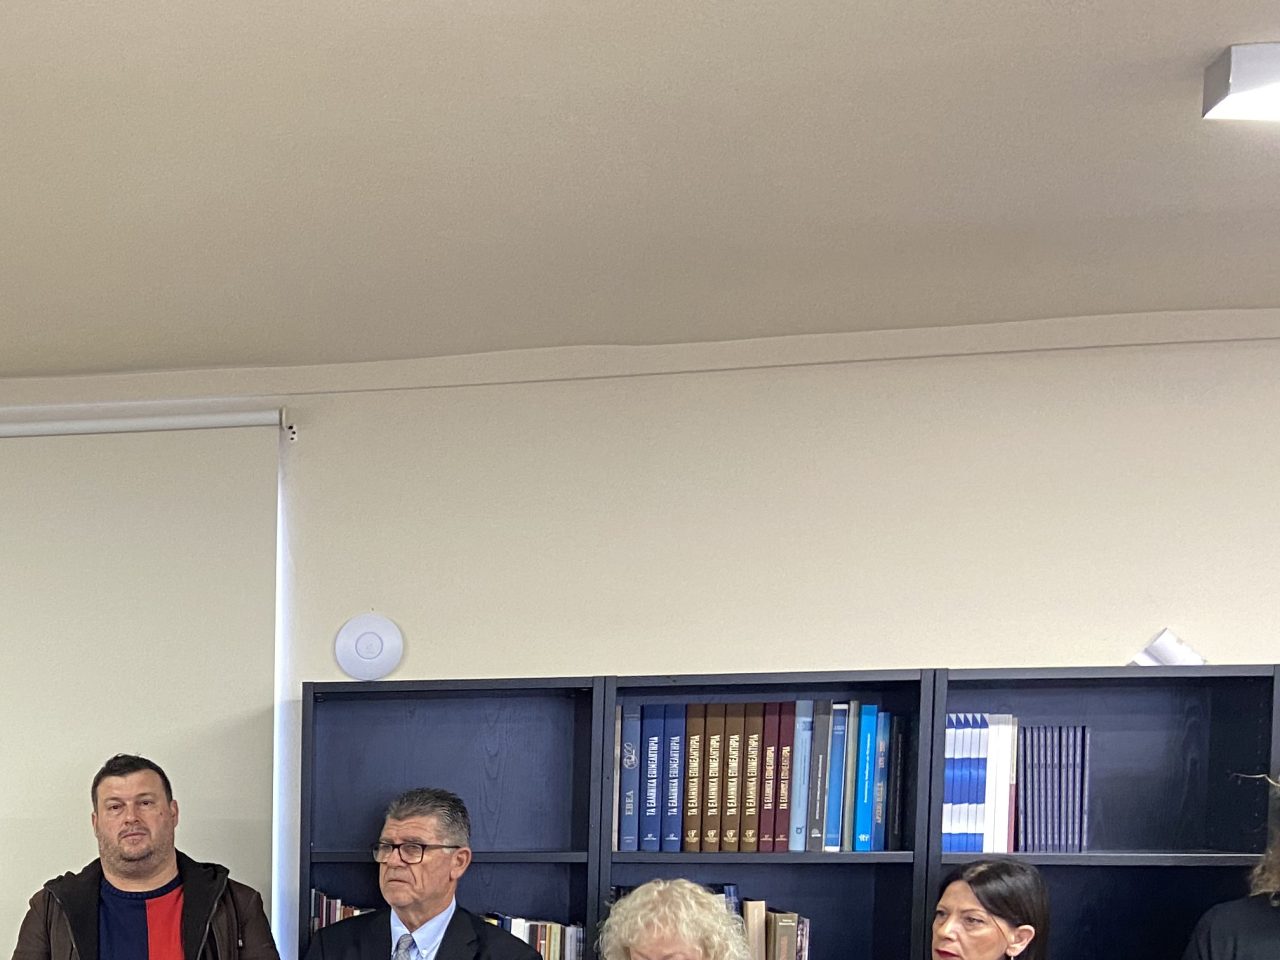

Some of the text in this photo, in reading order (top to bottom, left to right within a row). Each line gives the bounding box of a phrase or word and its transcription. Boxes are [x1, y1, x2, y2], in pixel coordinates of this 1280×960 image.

[646, 807, 656, 816] ΤΑ
[668, 807, 678, 816] ΤΑ
[687, 735, 700, 816] ΤΑ ΕΛΛΗΝΙΚΑ ΕΠΙΜΕΛΗΤΗΡΙΑ
[707, 735, 721, 816] ΤΑ ΕΛΛΗΝΙΚΑ ΕΠΙΜΕΛΗΤΗΡΙΑ
[726, 734, 740, 816] ΤΑ ΕΛΛΗΝΙΚΑ ΕΠΙΜΕΛΗΤΗΡΙΑ
[745, 734, 759, 816] ΤΑ ΕΛΛΗΝΙΚΑ ΕΠΙΜΕΛΗΤΗΡΙΑ
